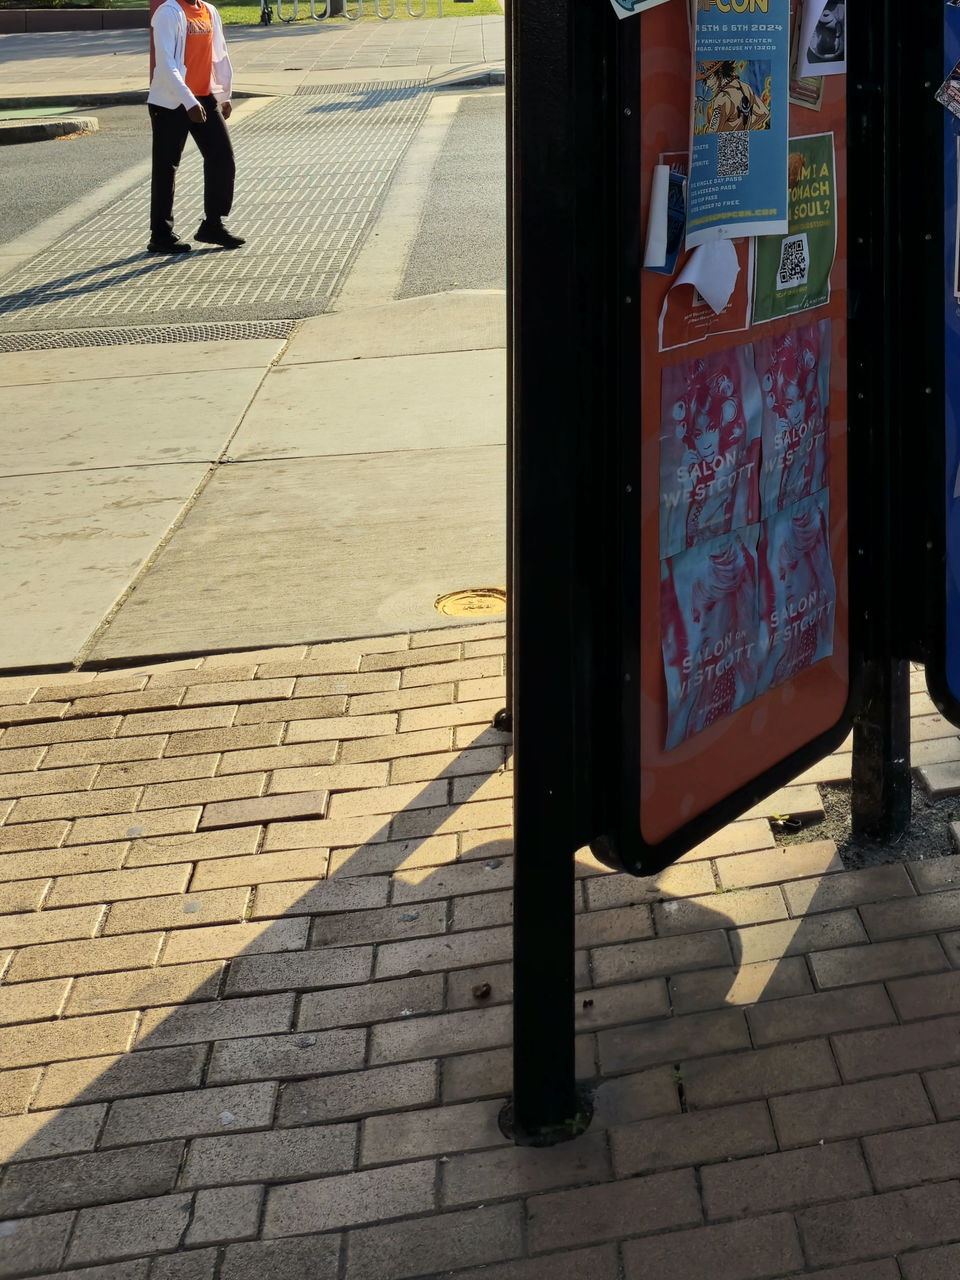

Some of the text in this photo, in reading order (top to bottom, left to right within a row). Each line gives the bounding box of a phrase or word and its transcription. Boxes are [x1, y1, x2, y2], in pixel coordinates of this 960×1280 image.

[820, 163, 829, 177] A
[794, 200, 831, 220] SOUL?
[764, 431, 826, 472] WESTCOTT
[774, 420, 816, 450] SALON
[676, 450, 738, 482] SALON
[663, 462, 755, 508] WESTCOTT
[770, 591, 818, 628] SALON
[682, 630, 746, 674] SALON ON
